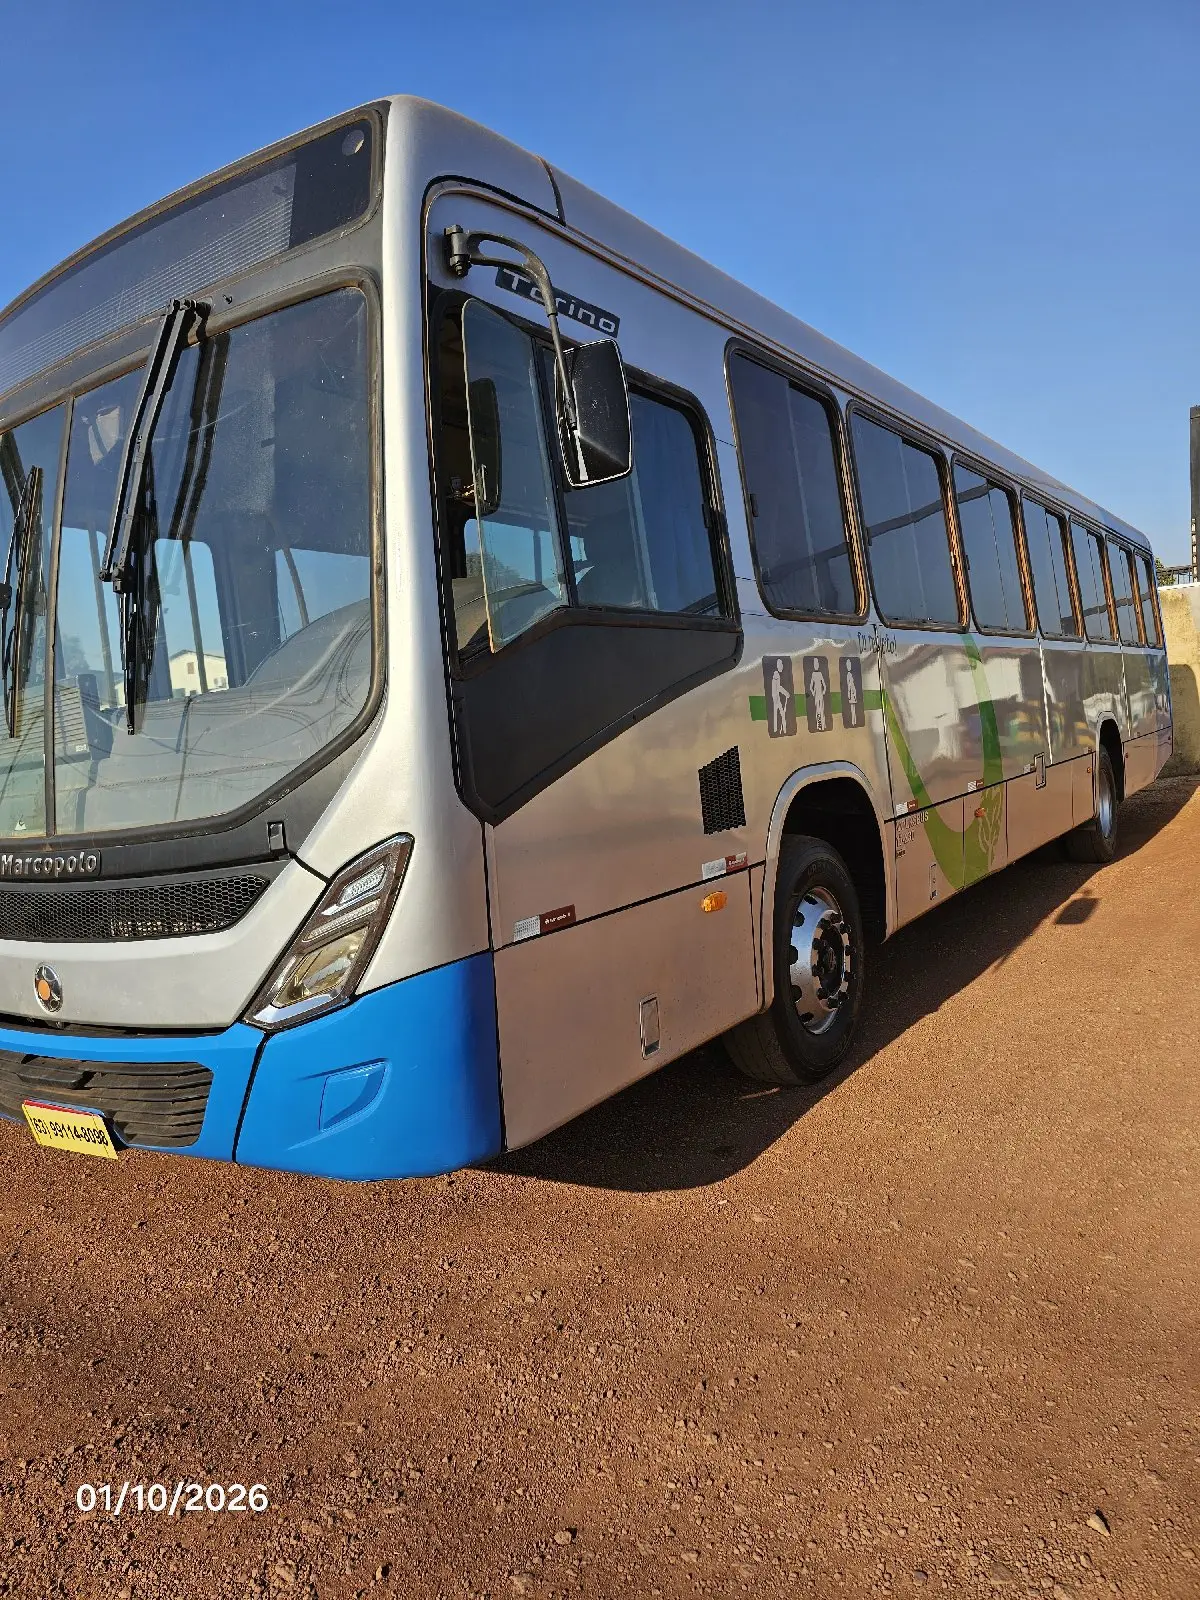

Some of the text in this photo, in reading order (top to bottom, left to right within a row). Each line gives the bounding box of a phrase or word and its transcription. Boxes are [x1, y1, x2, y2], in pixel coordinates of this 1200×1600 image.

[503, 268, 616, 333] Torino
[1, 851, 97, 878] Marcopolo
[49, 1120, 109, 1147] 99114-8098
